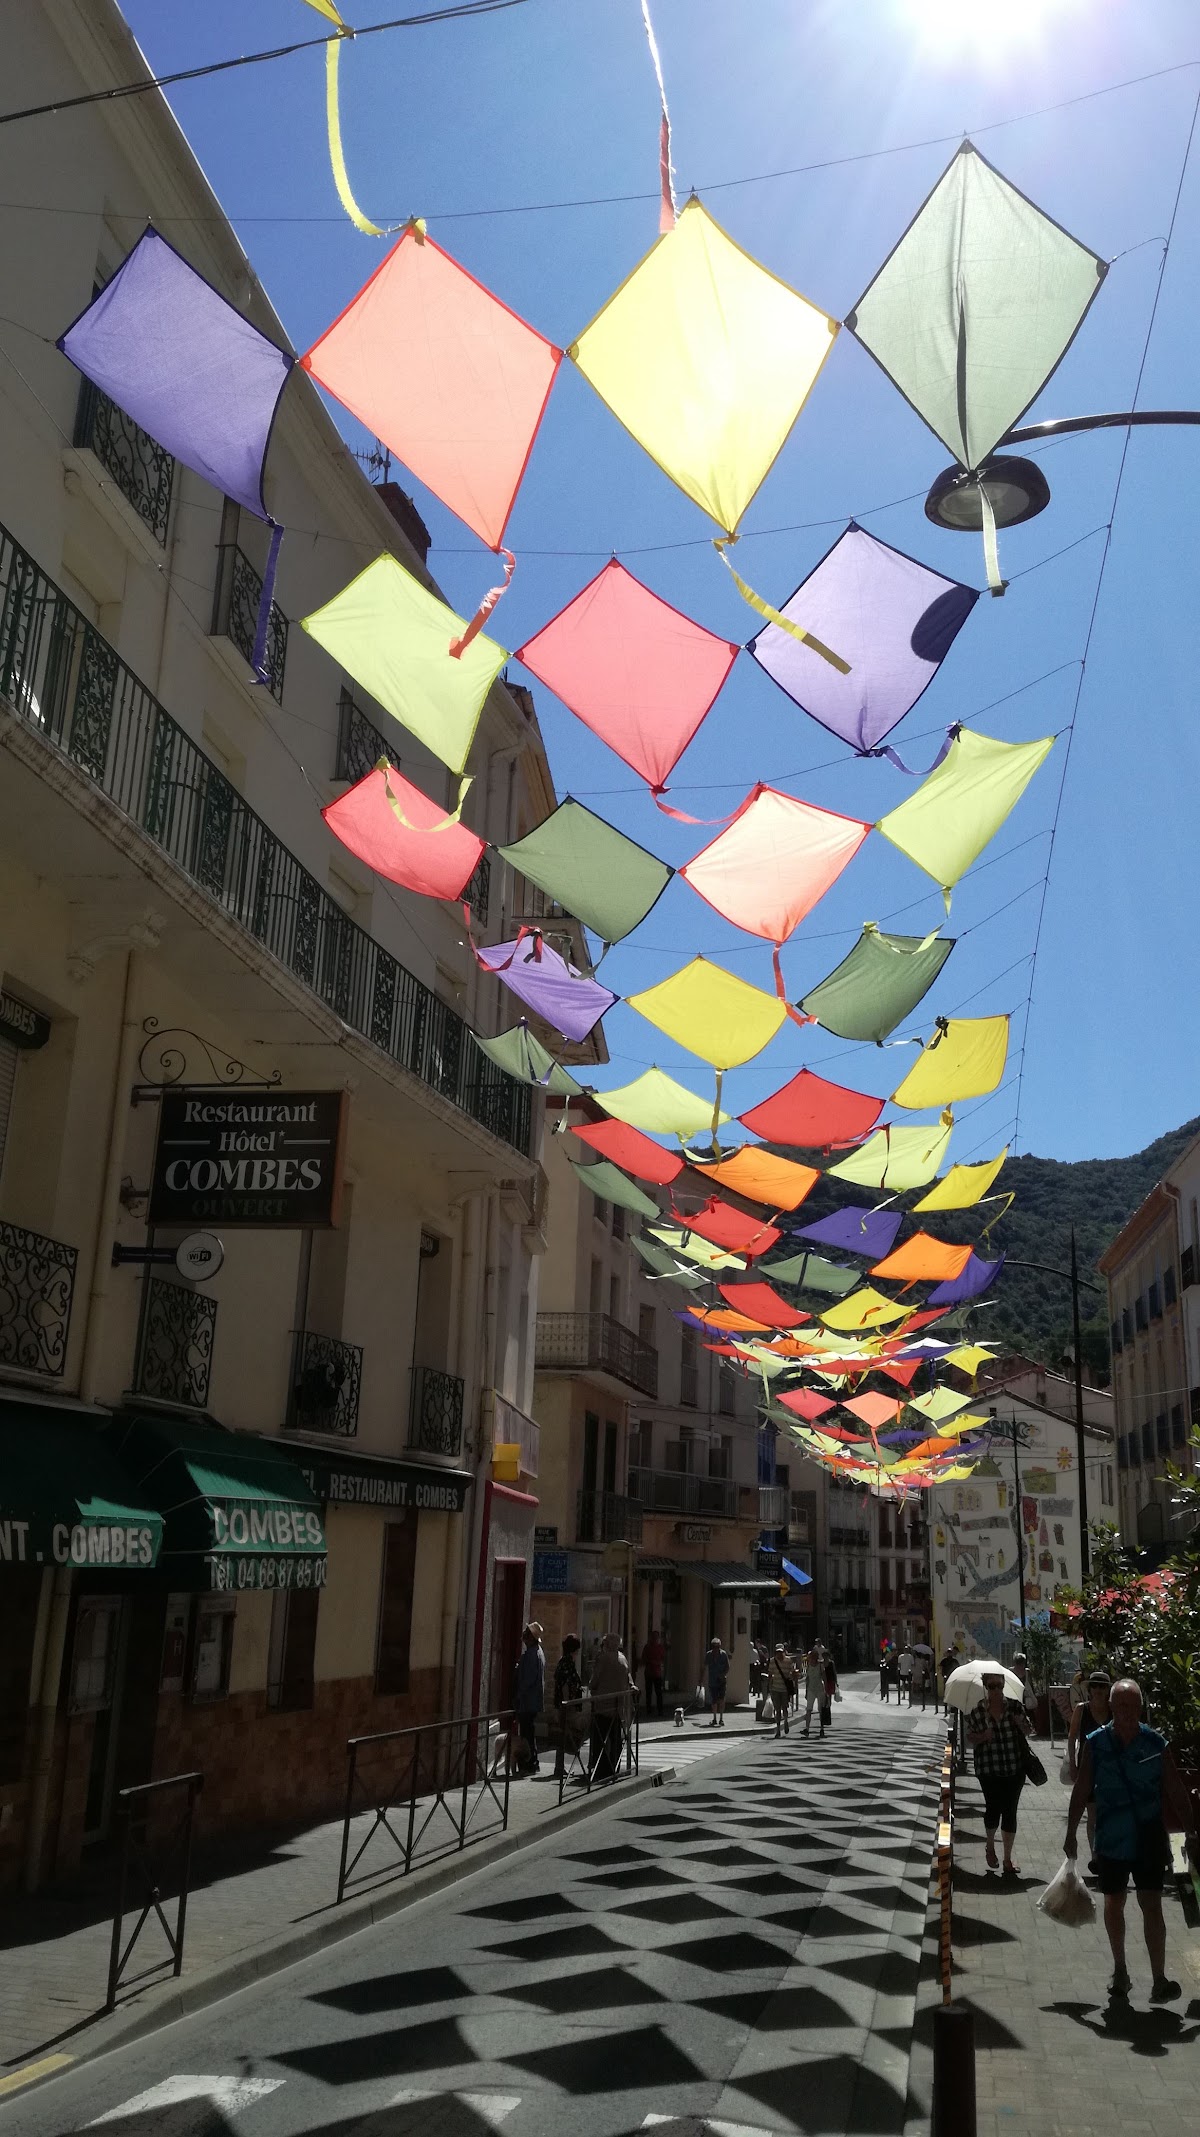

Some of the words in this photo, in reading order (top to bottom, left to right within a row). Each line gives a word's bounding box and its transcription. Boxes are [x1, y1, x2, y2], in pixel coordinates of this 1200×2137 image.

[183, 1101, 318, 1123] Restaurant
[165, 1159, 322, 1191] COMBES
[191, 1199, 289, 1216] OUVERT
[415, 1484, 458, 1510] COMBES
[213, 1506, 323, 1545] COMBES
[52, 1523, 153, 1564] COMBES
[759, 1553, 779, 1562] HOTEL
[238, 1558, 256, 1588] 04
[259, 1558, 277, 1588] 68
[277, 1559, 294, 1587] 87
[296, 1558, 312, 1587] 85
